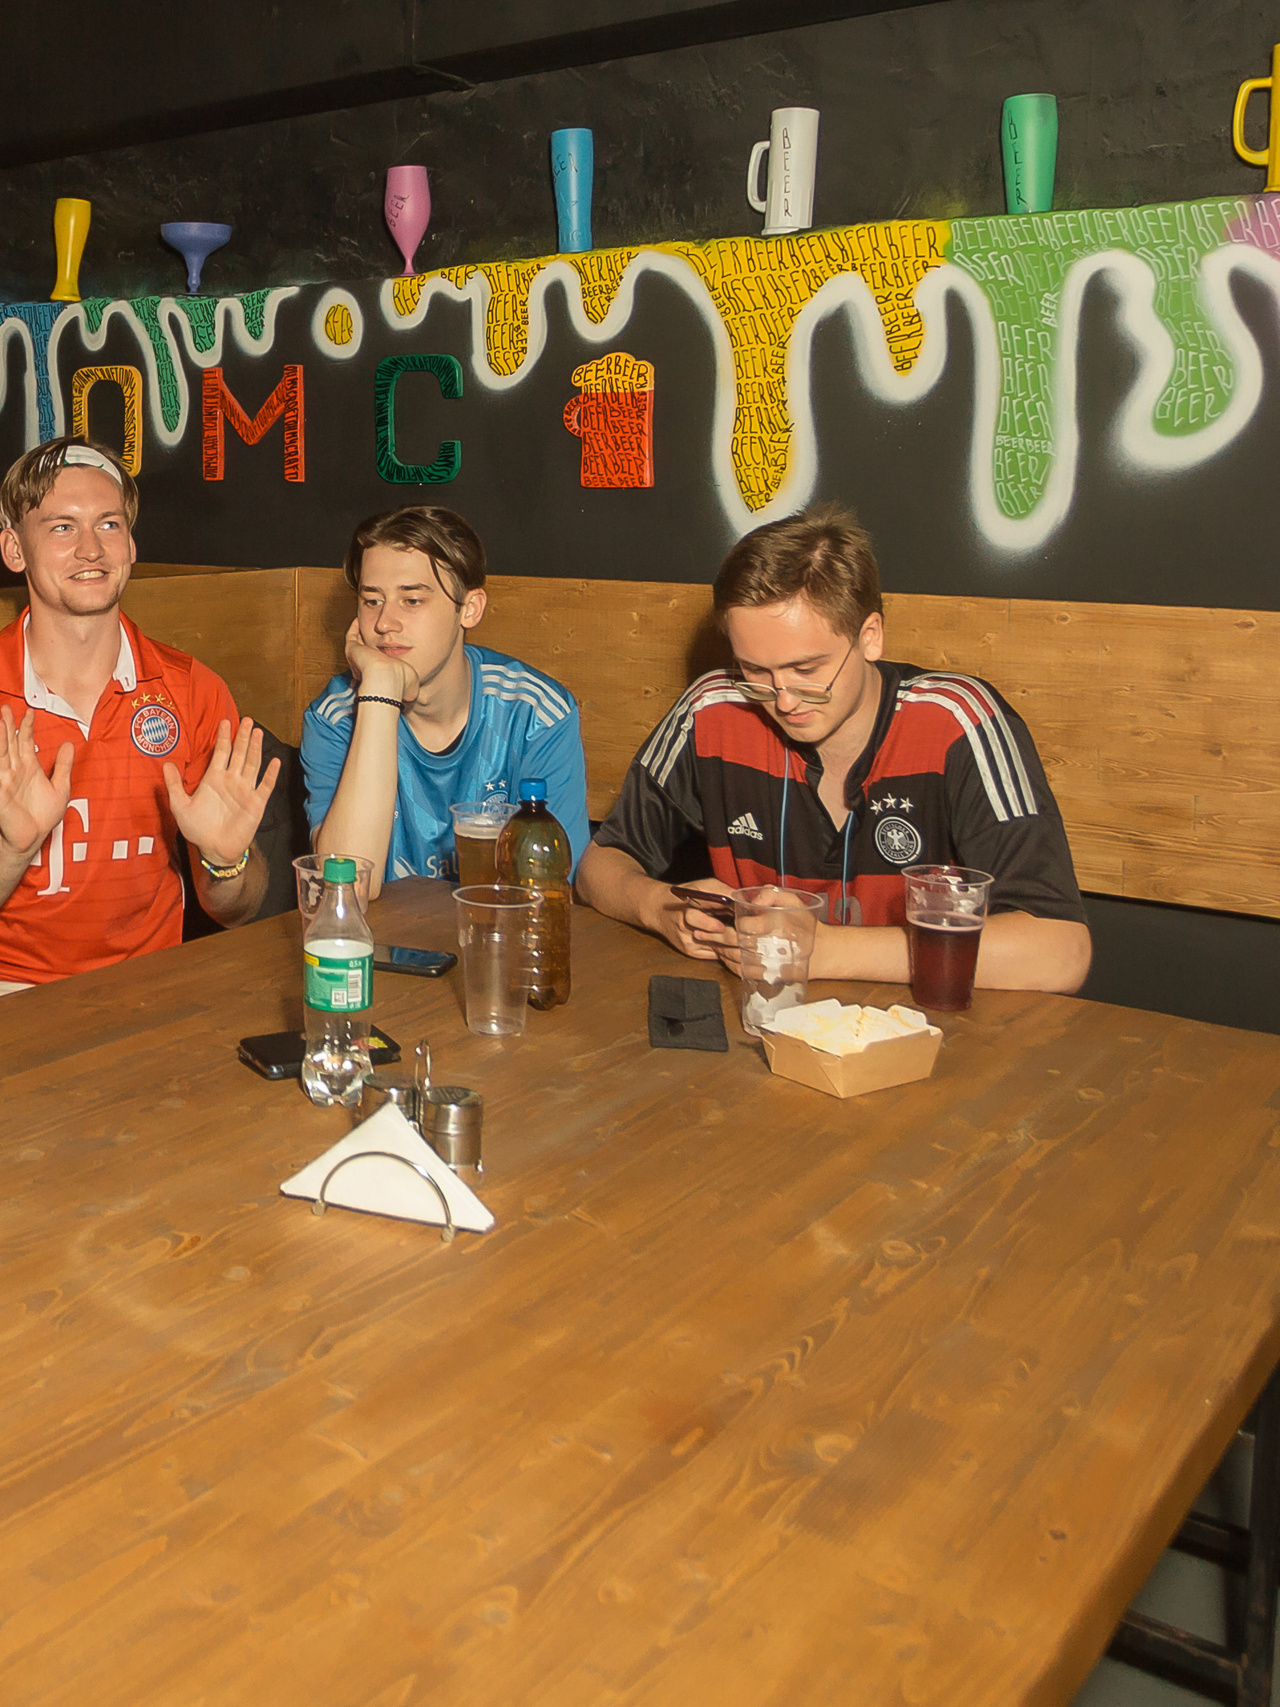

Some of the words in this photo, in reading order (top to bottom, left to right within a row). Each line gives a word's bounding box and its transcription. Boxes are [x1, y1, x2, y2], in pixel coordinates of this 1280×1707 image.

[552, 153, 578, 184] EER
[782, 127, 792, 217] BEER
[951, 218, 1003, 252] BEER
[999, 216, 1048, 249] BEER
[1044, 211, 1096, 251] BEER
[1129, 204, 1194, 246] BEER
[1190, 201, 1261, 249] BEER
[675, 241, 742, 278] BEER
[745, 239, 790, 273] BEER
[786, 234, 838, 268] BEER
[831, 225, 888, 264] BEER
[884, 223, 946, 261] BEER
[1135, 243, 1200, 282] BEER
[440, 265, 479, 290] BEER
[482, 264, 525, 295] BEER
[521, 263, 547, 294] BEER
[569, 256, 608, 286] BEER
[605, 251, 640, 283] BEER
[953, 251, 1024, 287] BEER
[241, 292, 264, 313] BEER
[393, 274, 427, 316] BEER
[581, 284, 607, 300] BEER
[721, 275, 777, 315] BEER
[766, 268, 818, 308] BEER
[810, 263, 849, 288] BEER
[851, 261, 895, 290] BEER
[891, 259, 942, 289] BEER
[83, 299, 111, 334] BEER
[130, 299, 152, 322] BEER
[180, 302, 207, 325] BEER
[245, 305, 264, 325] BEER
[487, 293, 521, 324] BEER
[520, 297, 529, 326] BEER
[583, 295, 615, 324] BEER
[875, 290, 901, 336] BEER
[895, 287, 922, 327] BEER
[1040, 291, 1060, 328] BEER
[145, 322, 167, 342] BEER
[191, 320, 217, 354] BEER
[325, 303, 354, 346] BEER
[486, 322, 519, 351] BEER
[724, 315, 767, 349] BEER
[759, 306, 802, 346] BEER
[998, 320, 1056, 362] BEER
[486, 350, 525, 377] BEER
[573, 356, 613, 384] BEER
[613, 354, 650, 382] BEER
[734, 347, 774, 380] BEER
[771, 333, 792, 375] BEER
[1002, 357, 1053, 401] BEER
[1171, 348, 1234, 396] BEER
[583, 378, 611, 407] BEER
[609, 376, 638, 409] BEER
[736, 381, 769, 406] BEER
[1156, 387, 1221, 428] BEER
[583, 405, 613, 434] BEER
[609, 406, 647, 422] BEER
[610, 419, 648, 437] BEER
[733, 406, 770, 434] BEER
[998, 396, 1055, 440] BEER
[583, 431, 615, 456] BEER
[610, 435, 649, 459] BEER
[731, 435, 771, 469] BEER
[995, 435, 1026, 450] BEER
[583, 452, 614, 476] BEER
[609, 452, 645, 477] BEER
[735, 467, 773, 495] BEER
[993, 447, 1049, 485] BEER
[996, 482, 1042, 517] BEER
[142, 708, 176, 730] BAYERN
[727, 825, 764, 841] adidas
